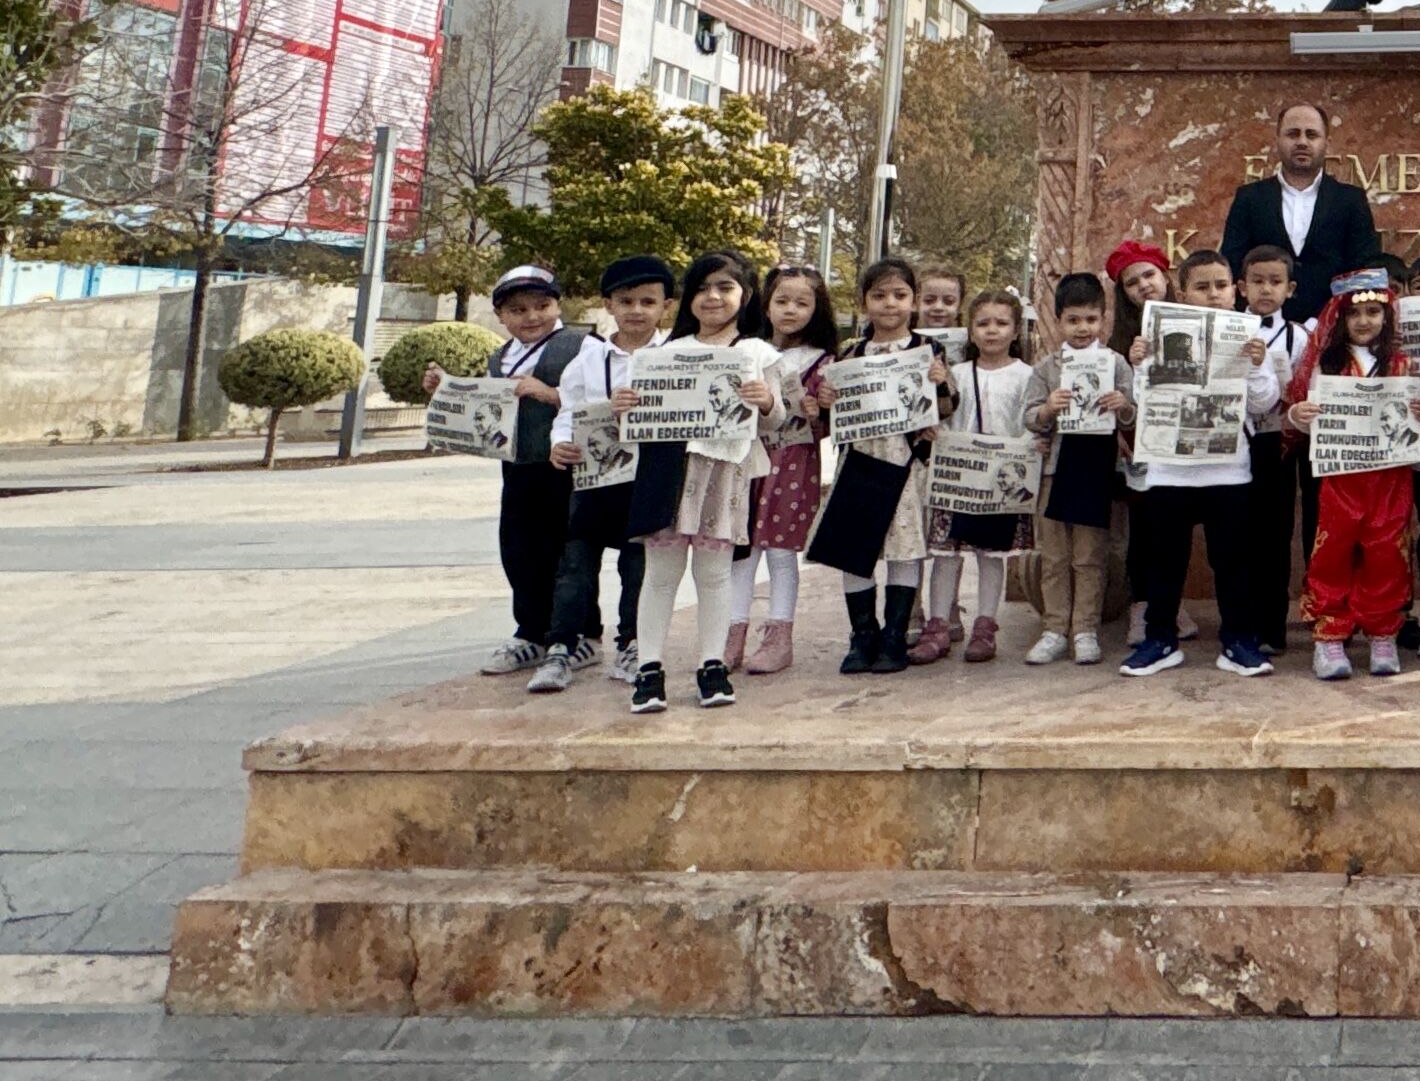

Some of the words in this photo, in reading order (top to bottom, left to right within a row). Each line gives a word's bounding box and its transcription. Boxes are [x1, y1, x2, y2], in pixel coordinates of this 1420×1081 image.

[631, 376, 697, 391] EFENDİLER!
[635, 395, 663, 407] ARIN
[835, 400, 862, 413] YARIN
[628, 409, 706, 424] CUMHURİYETİ
[1317, 419, 1346, 430] YARIN
[933, 468, 961, 481] YARIN
